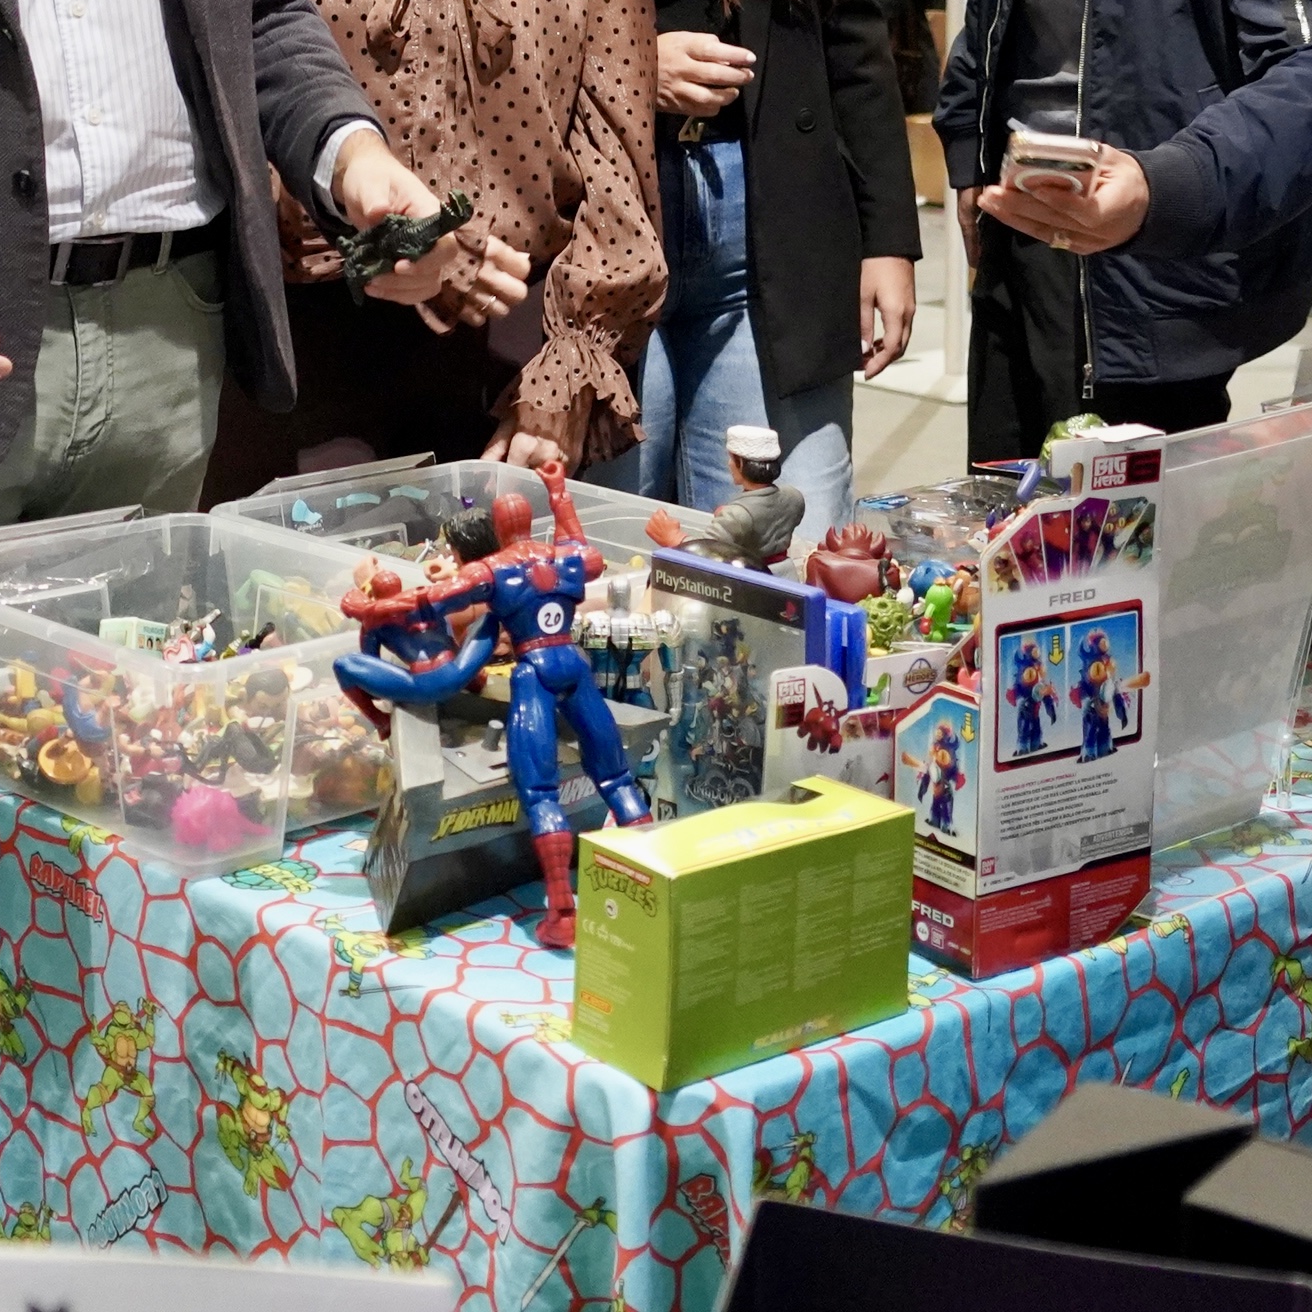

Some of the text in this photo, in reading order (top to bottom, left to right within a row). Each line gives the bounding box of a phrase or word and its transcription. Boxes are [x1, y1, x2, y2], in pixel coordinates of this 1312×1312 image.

[1093, 473, 1126, 488] HERO
[1094, 455, 1127, 477] BIG
[1049, 588, 1096, 607] FRED
[544, 612, 562, 628] 20
[430, 800, 520, 842] SPIDER-MAN
[30, 851, 104, 923] RAPHAEL
[584, 861, 658, 918] TURTLES
[912, 899, 955, 928] FRED
[404, 1080, 511, 1245] DONATELLO
